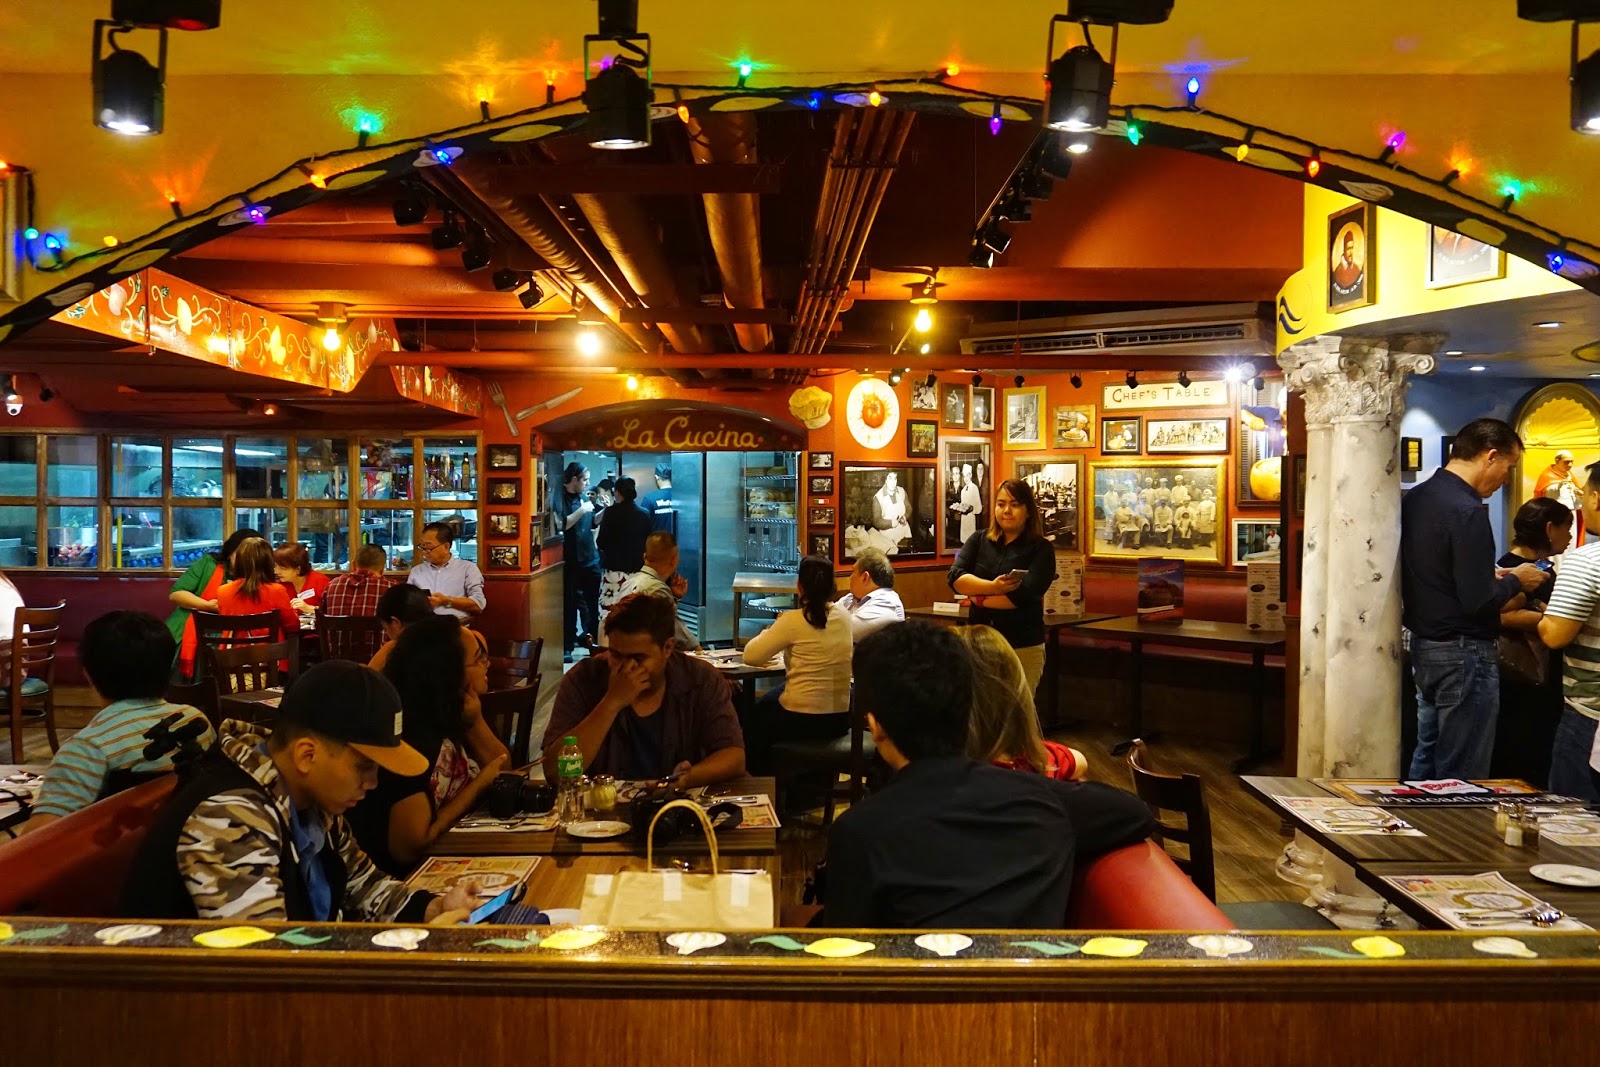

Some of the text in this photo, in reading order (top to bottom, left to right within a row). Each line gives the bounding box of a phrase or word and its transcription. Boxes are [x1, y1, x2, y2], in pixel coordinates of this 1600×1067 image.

[1112, 386, 1211, 403] CHEF'S TABLE
[613, 415, 759, 449] La Cucina
